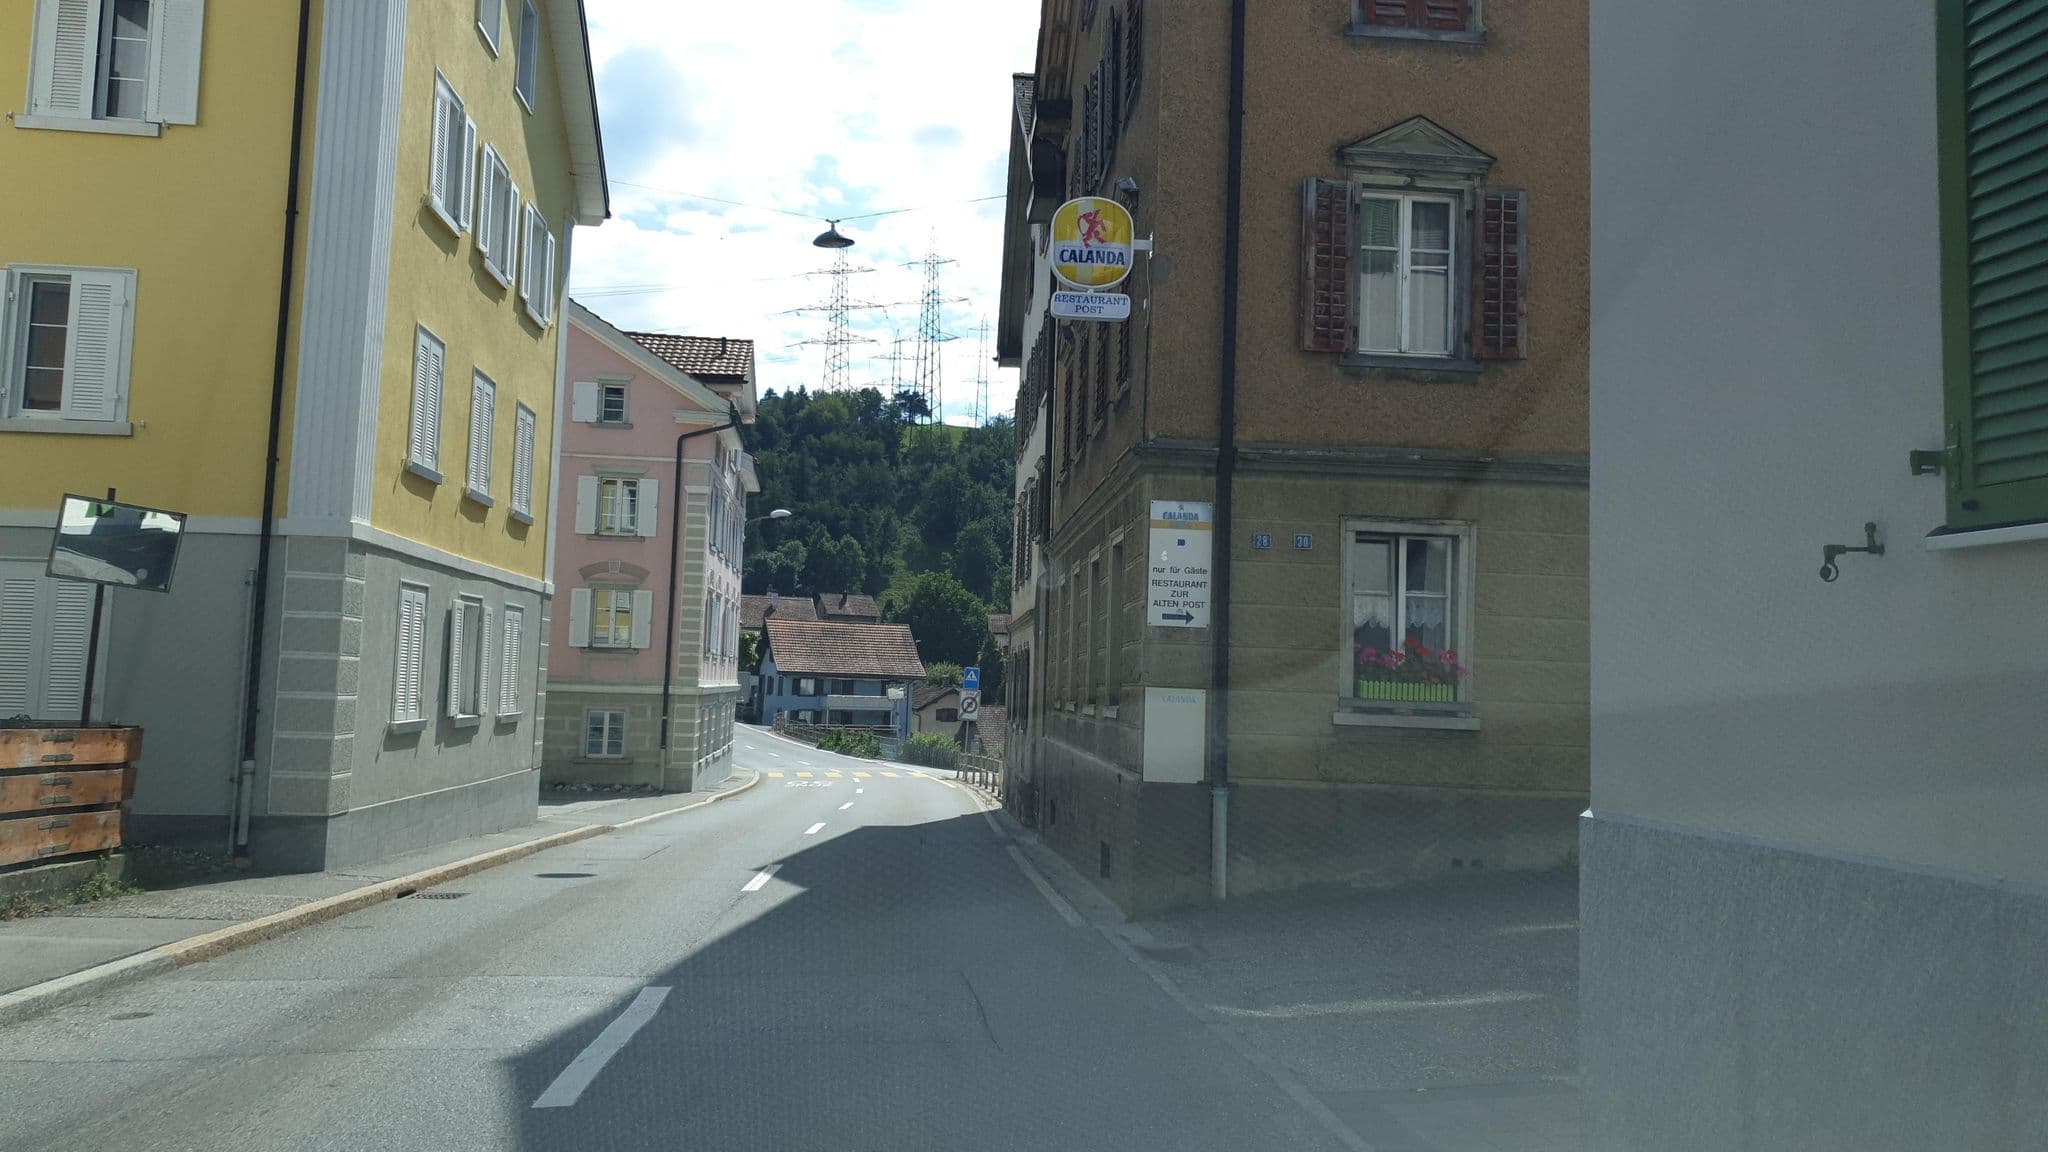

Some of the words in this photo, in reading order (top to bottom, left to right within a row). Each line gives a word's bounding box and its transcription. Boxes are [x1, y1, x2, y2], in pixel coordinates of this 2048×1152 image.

[1060, 249, 1125, 265] CALANDA
[1054, 294, 1128, 305] RESTAURANT
[1075, 305, 1104, 314] POST
[1162, 511, 1199, 520] CALANDA
[1169, 566, 1181, 574] für
[1184, 566, 1208, 575] Gäste
[1151, 579, 1208, 588] RESTAURANT
[1170, 590, 1189, 598] ZUR
[1152, 600, 1179, 608] ALTEN
[1183, 600, 1205, 609] POST
